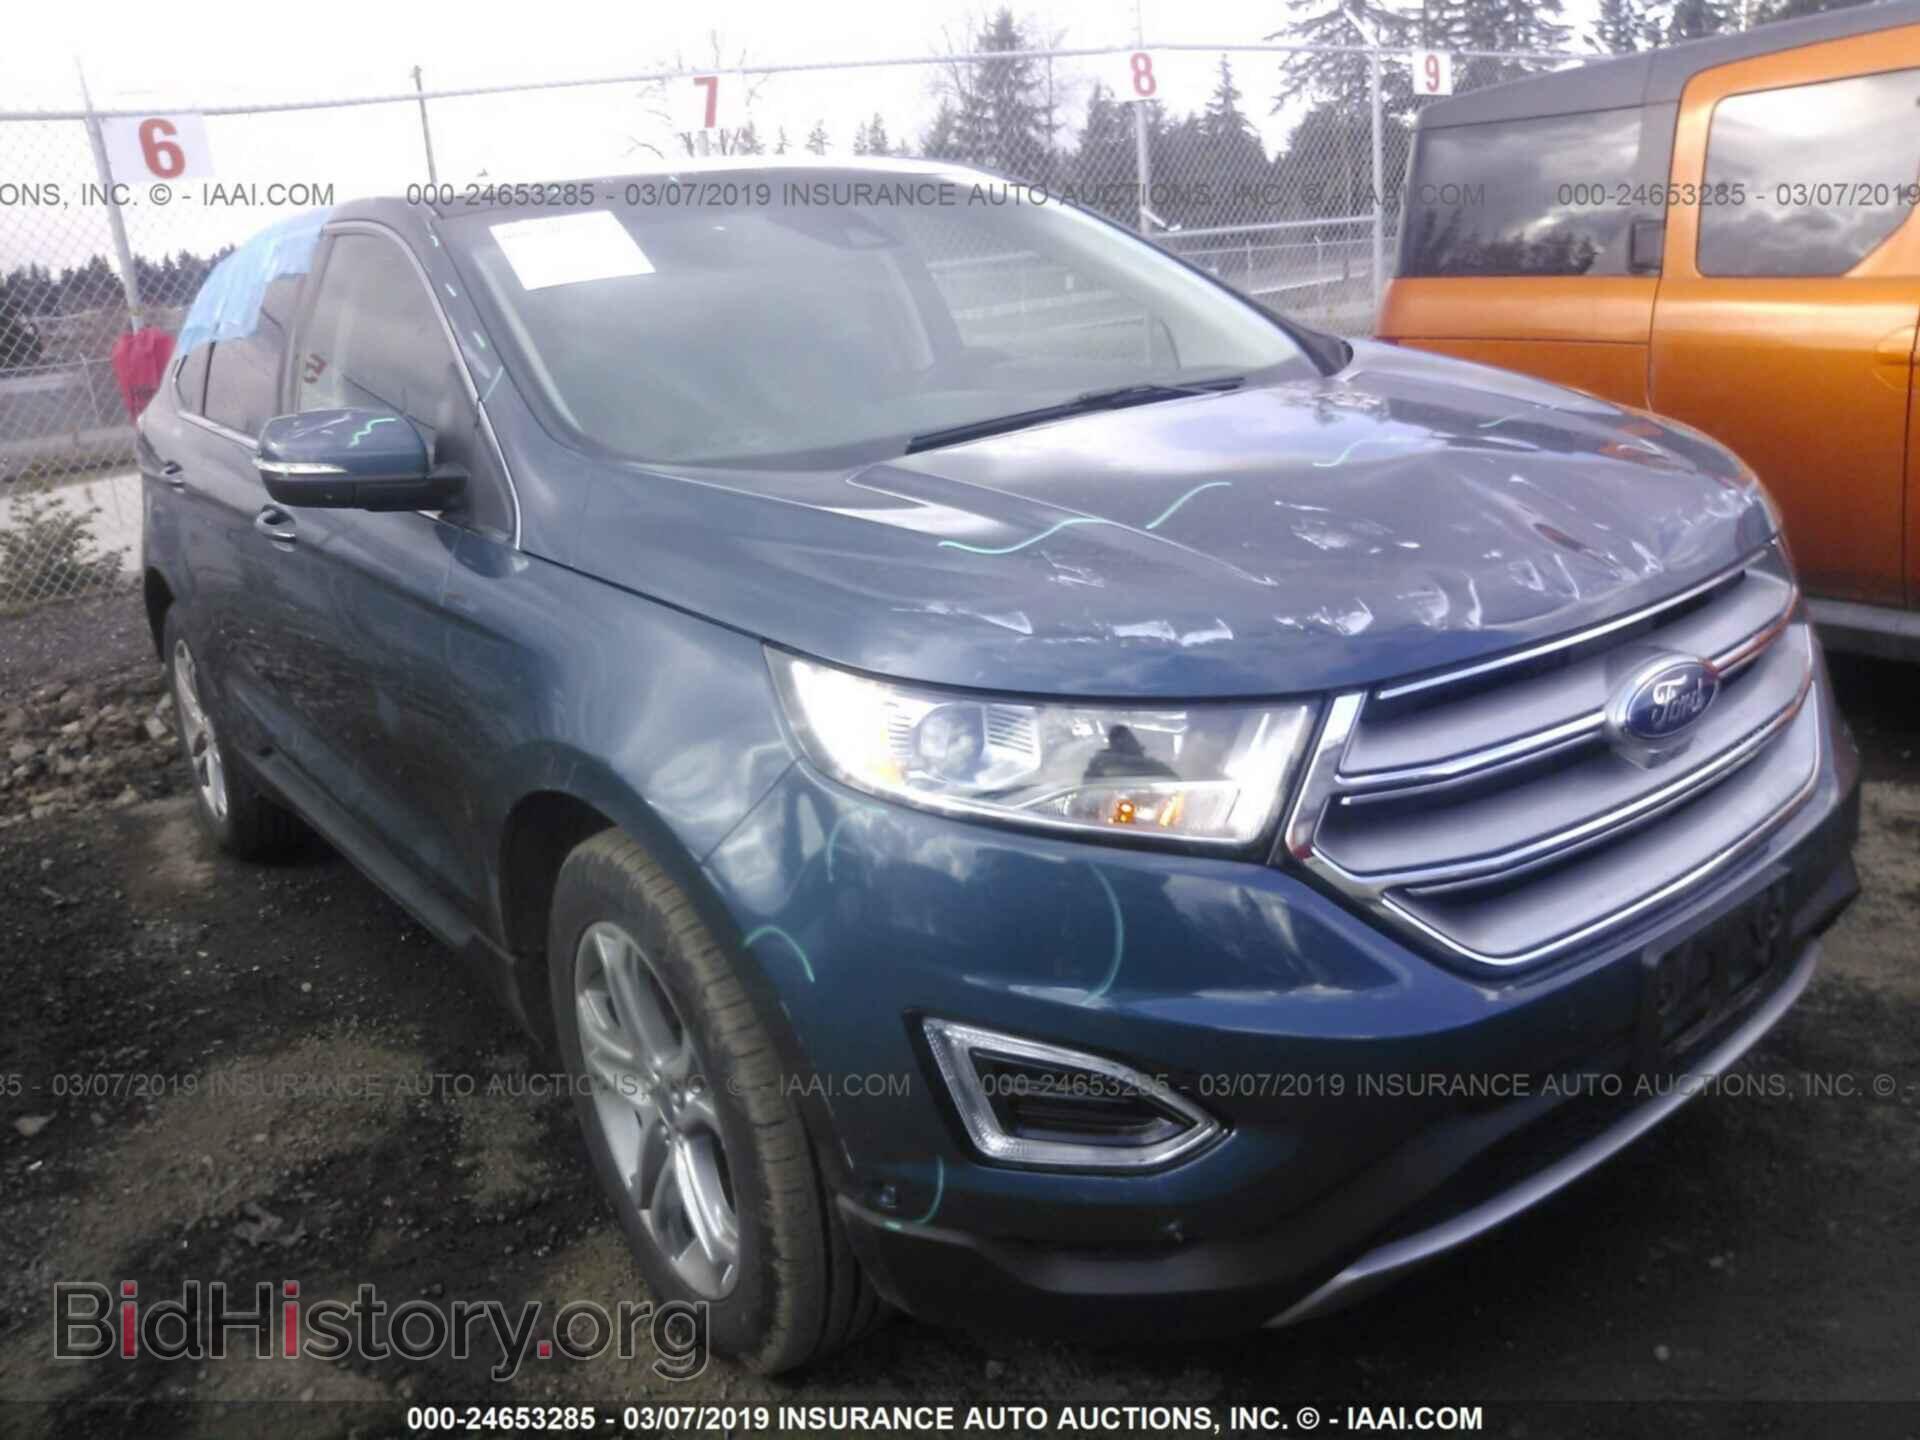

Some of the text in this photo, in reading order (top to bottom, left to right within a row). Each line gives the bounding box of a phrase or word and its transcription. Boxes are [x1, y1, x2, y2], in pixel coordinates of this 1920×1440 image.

[1130, 52, 1157, 97] 8
[1426, 54, 1441, 92] 9
[693, 76, 719, 128] 7
[138, 117, 186, 180] 6
[1652, 674, 1705, 727] Ford
